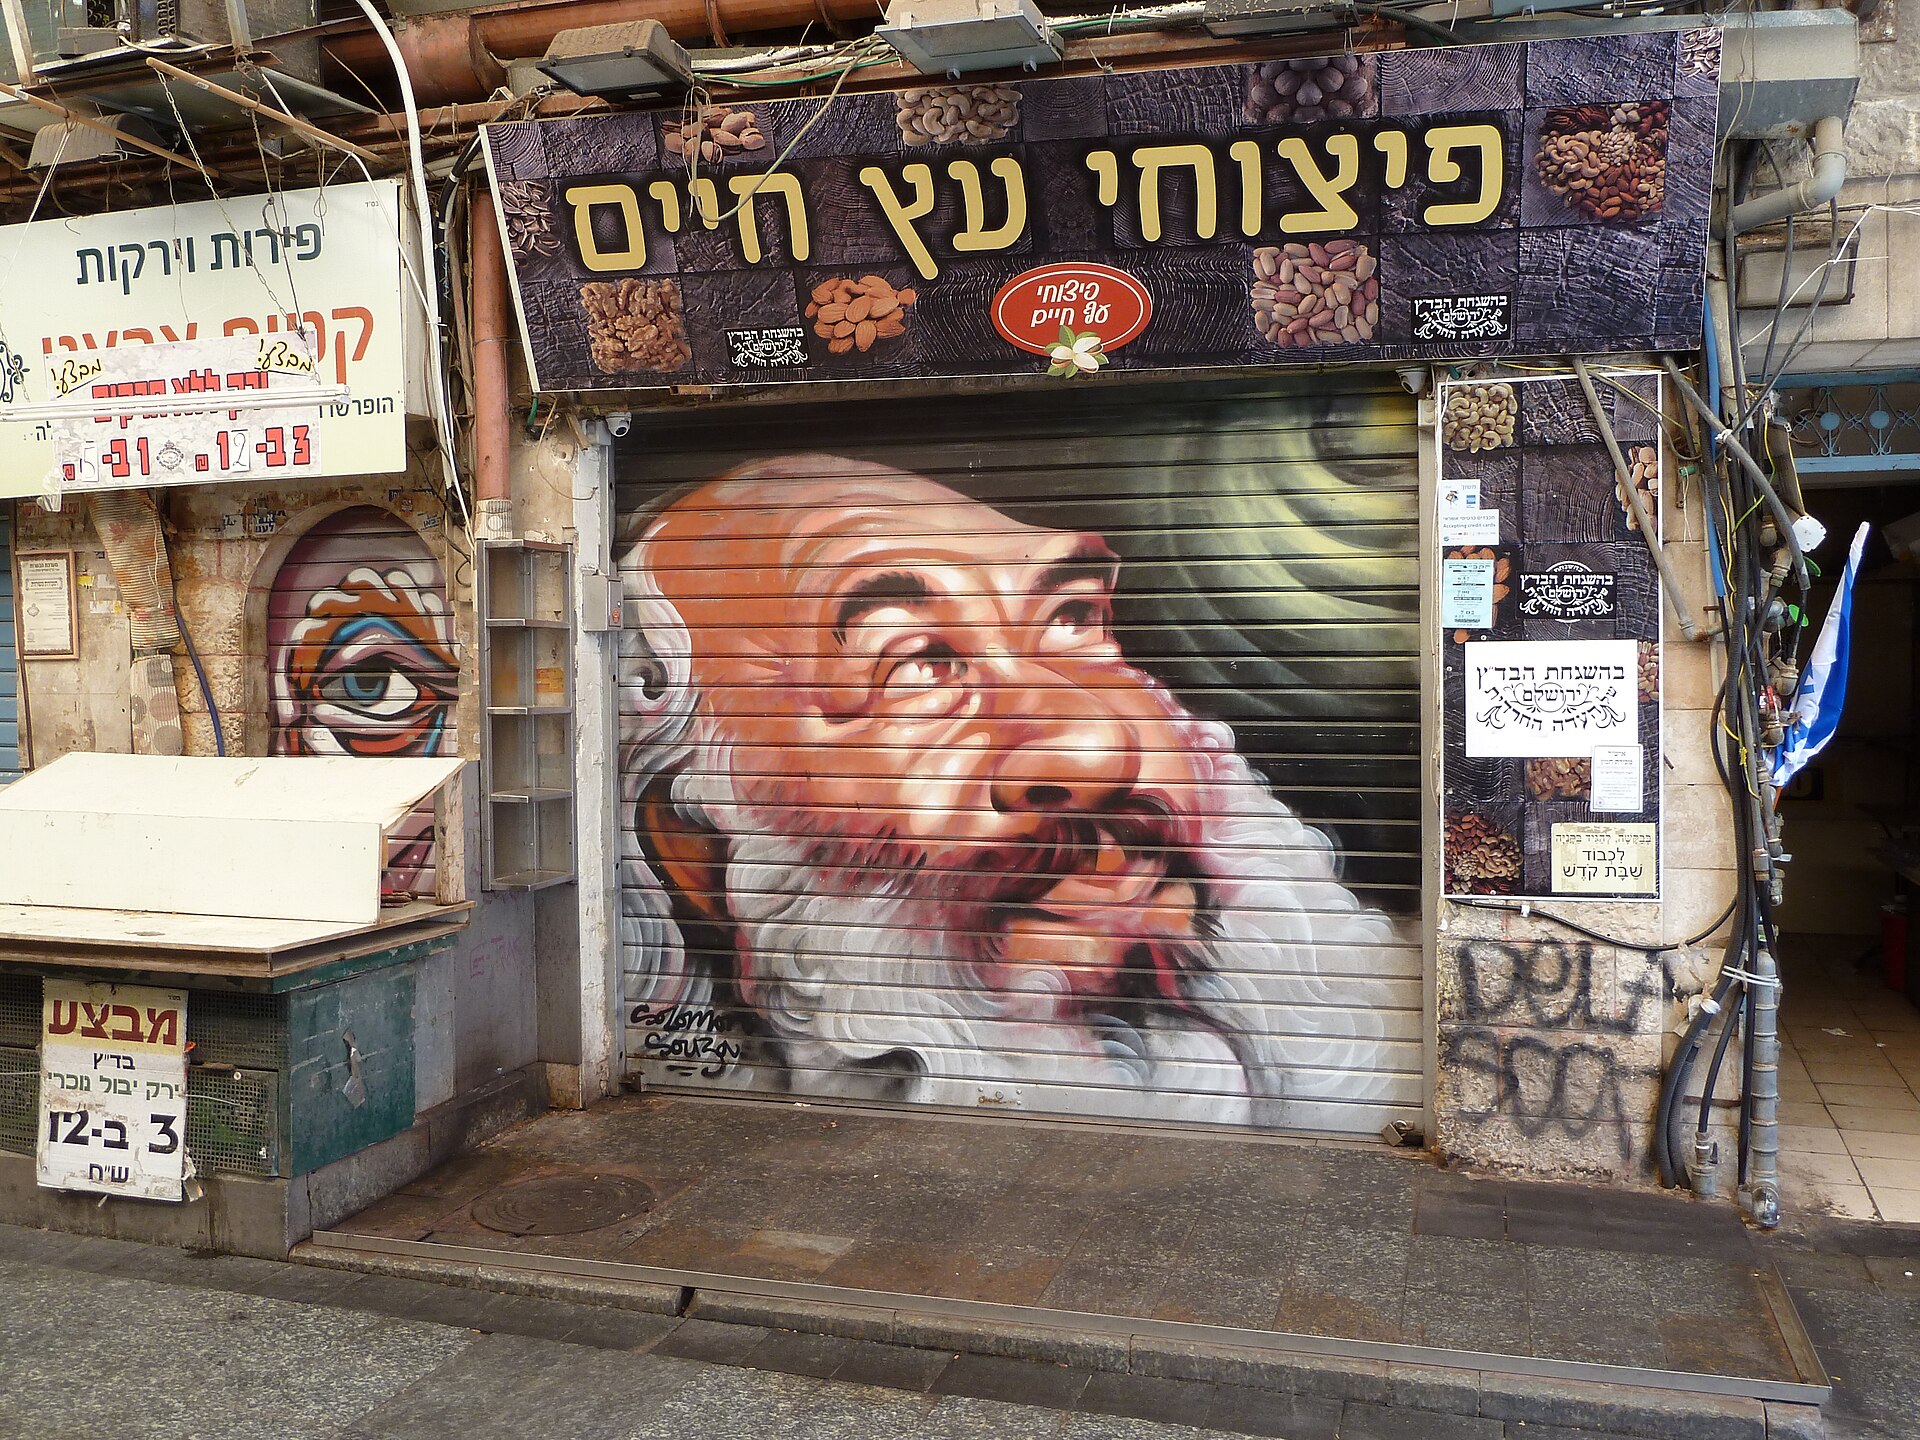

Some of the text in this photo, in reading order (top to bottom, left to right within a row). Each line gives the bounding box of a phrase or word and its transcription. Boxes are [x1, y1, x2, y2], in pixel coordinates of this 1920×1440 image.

[565, 124, 1503, 280] פיצוחי עץ חיים
[76, 223, 322, 296] פירות וירקות
[1036, 279, 1100, 304] פיצוחי
[1456, 295, 1508, 308] בהשגחת
[1030, 306, 1075, 328] חיים
[762, 327, 805, 339] בהשגחת
[137, 436, 151, 476] 1
[292, 425, 311, 466] 3
[1561, 574, 1614, 585] בהשגחת
[1476, 665, 1625, 690] בהשגחת הבד"ץ
[1484, 686, 1543, 731] החרדית
[1552, 705, 1602, 732] העדה
[48, 999, 178, 1046] מבצע
[93, 1052, 136, 1070] בד"ץ
[48, 1071, 180, 1101] ירק יבול נוכרי
[148, 1113, 179, 1155] 3
[89, 1162, 130, 1184] ש"ח
